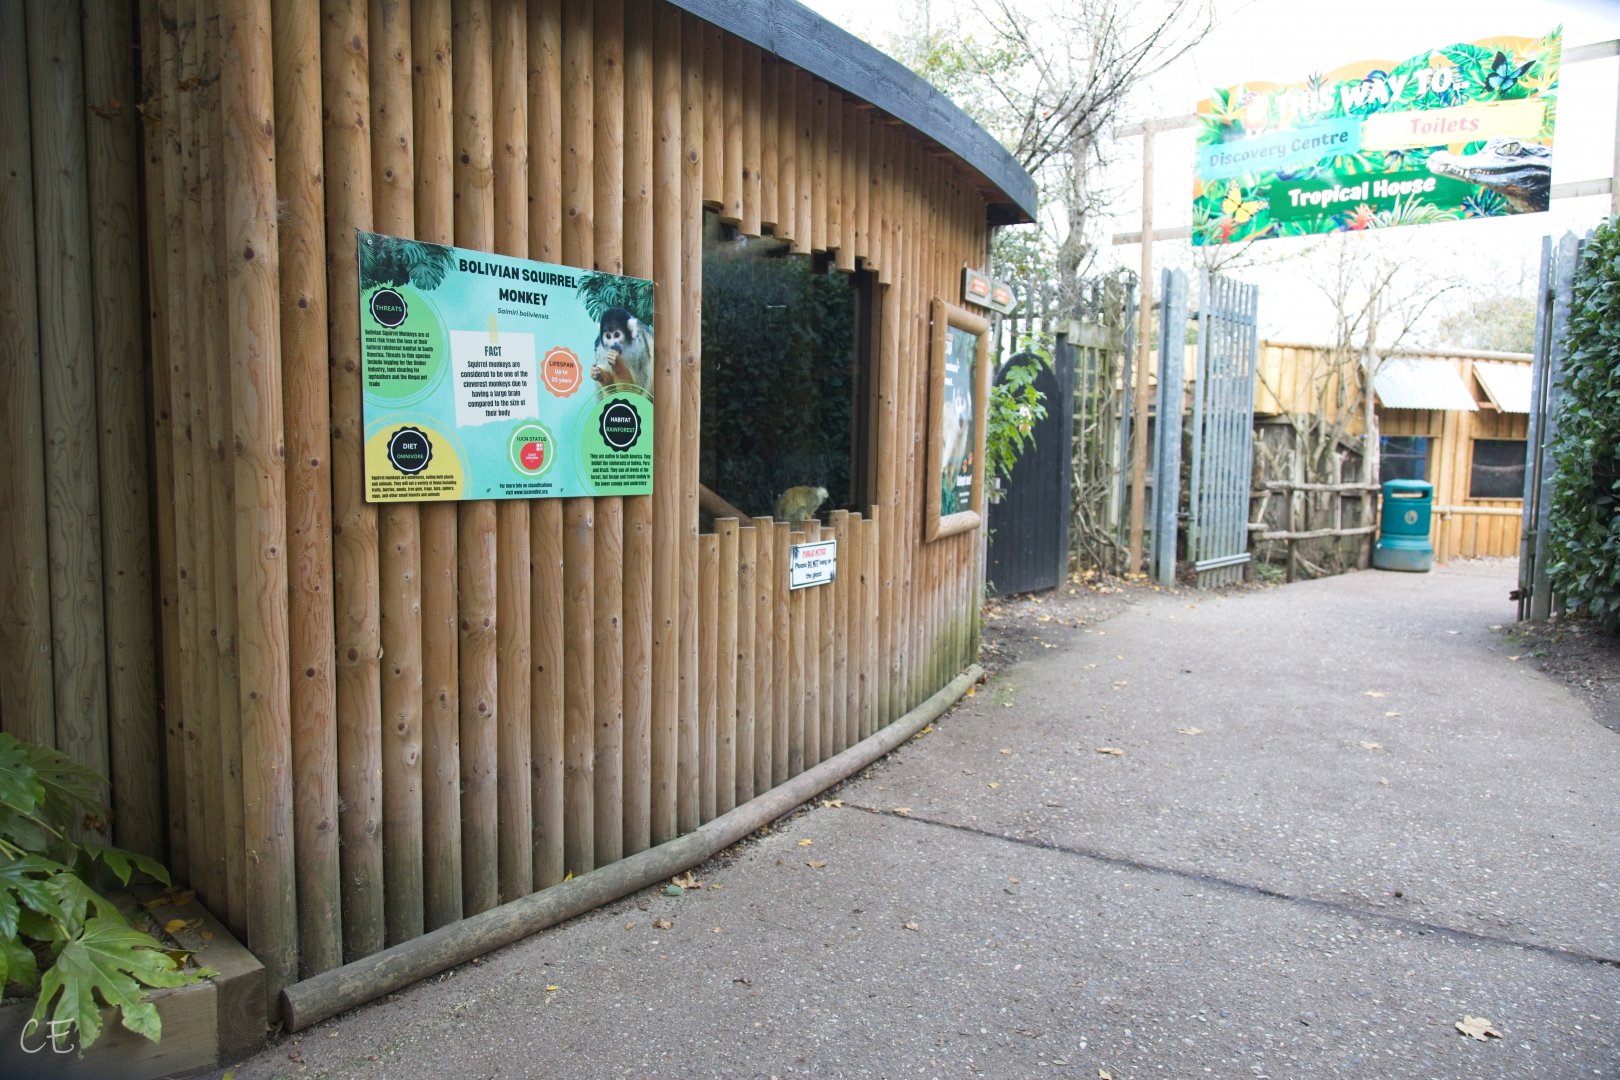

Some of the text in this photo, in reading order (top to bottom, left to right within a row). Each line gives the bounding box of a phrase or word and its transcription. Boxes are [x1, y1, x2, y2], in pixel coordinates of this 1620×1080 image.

[1340, 75, 1407, 114] WAY
[1410, 116, 1480, 135] Toilets
[1209, 130, 1349, 168] Discovery Centre
[1288, 177, 1436, 208] Tropical House
[459, 258, 578, 289] BOLIVIAN SQUIRREL
[499, 287, 548, 306] MONKEY
[484, 345, 502, 357] FACT
[489, 380, 511, 388] monkeys
[472, 390, 489, 398] having
[468, 400, 493, 408] compared
